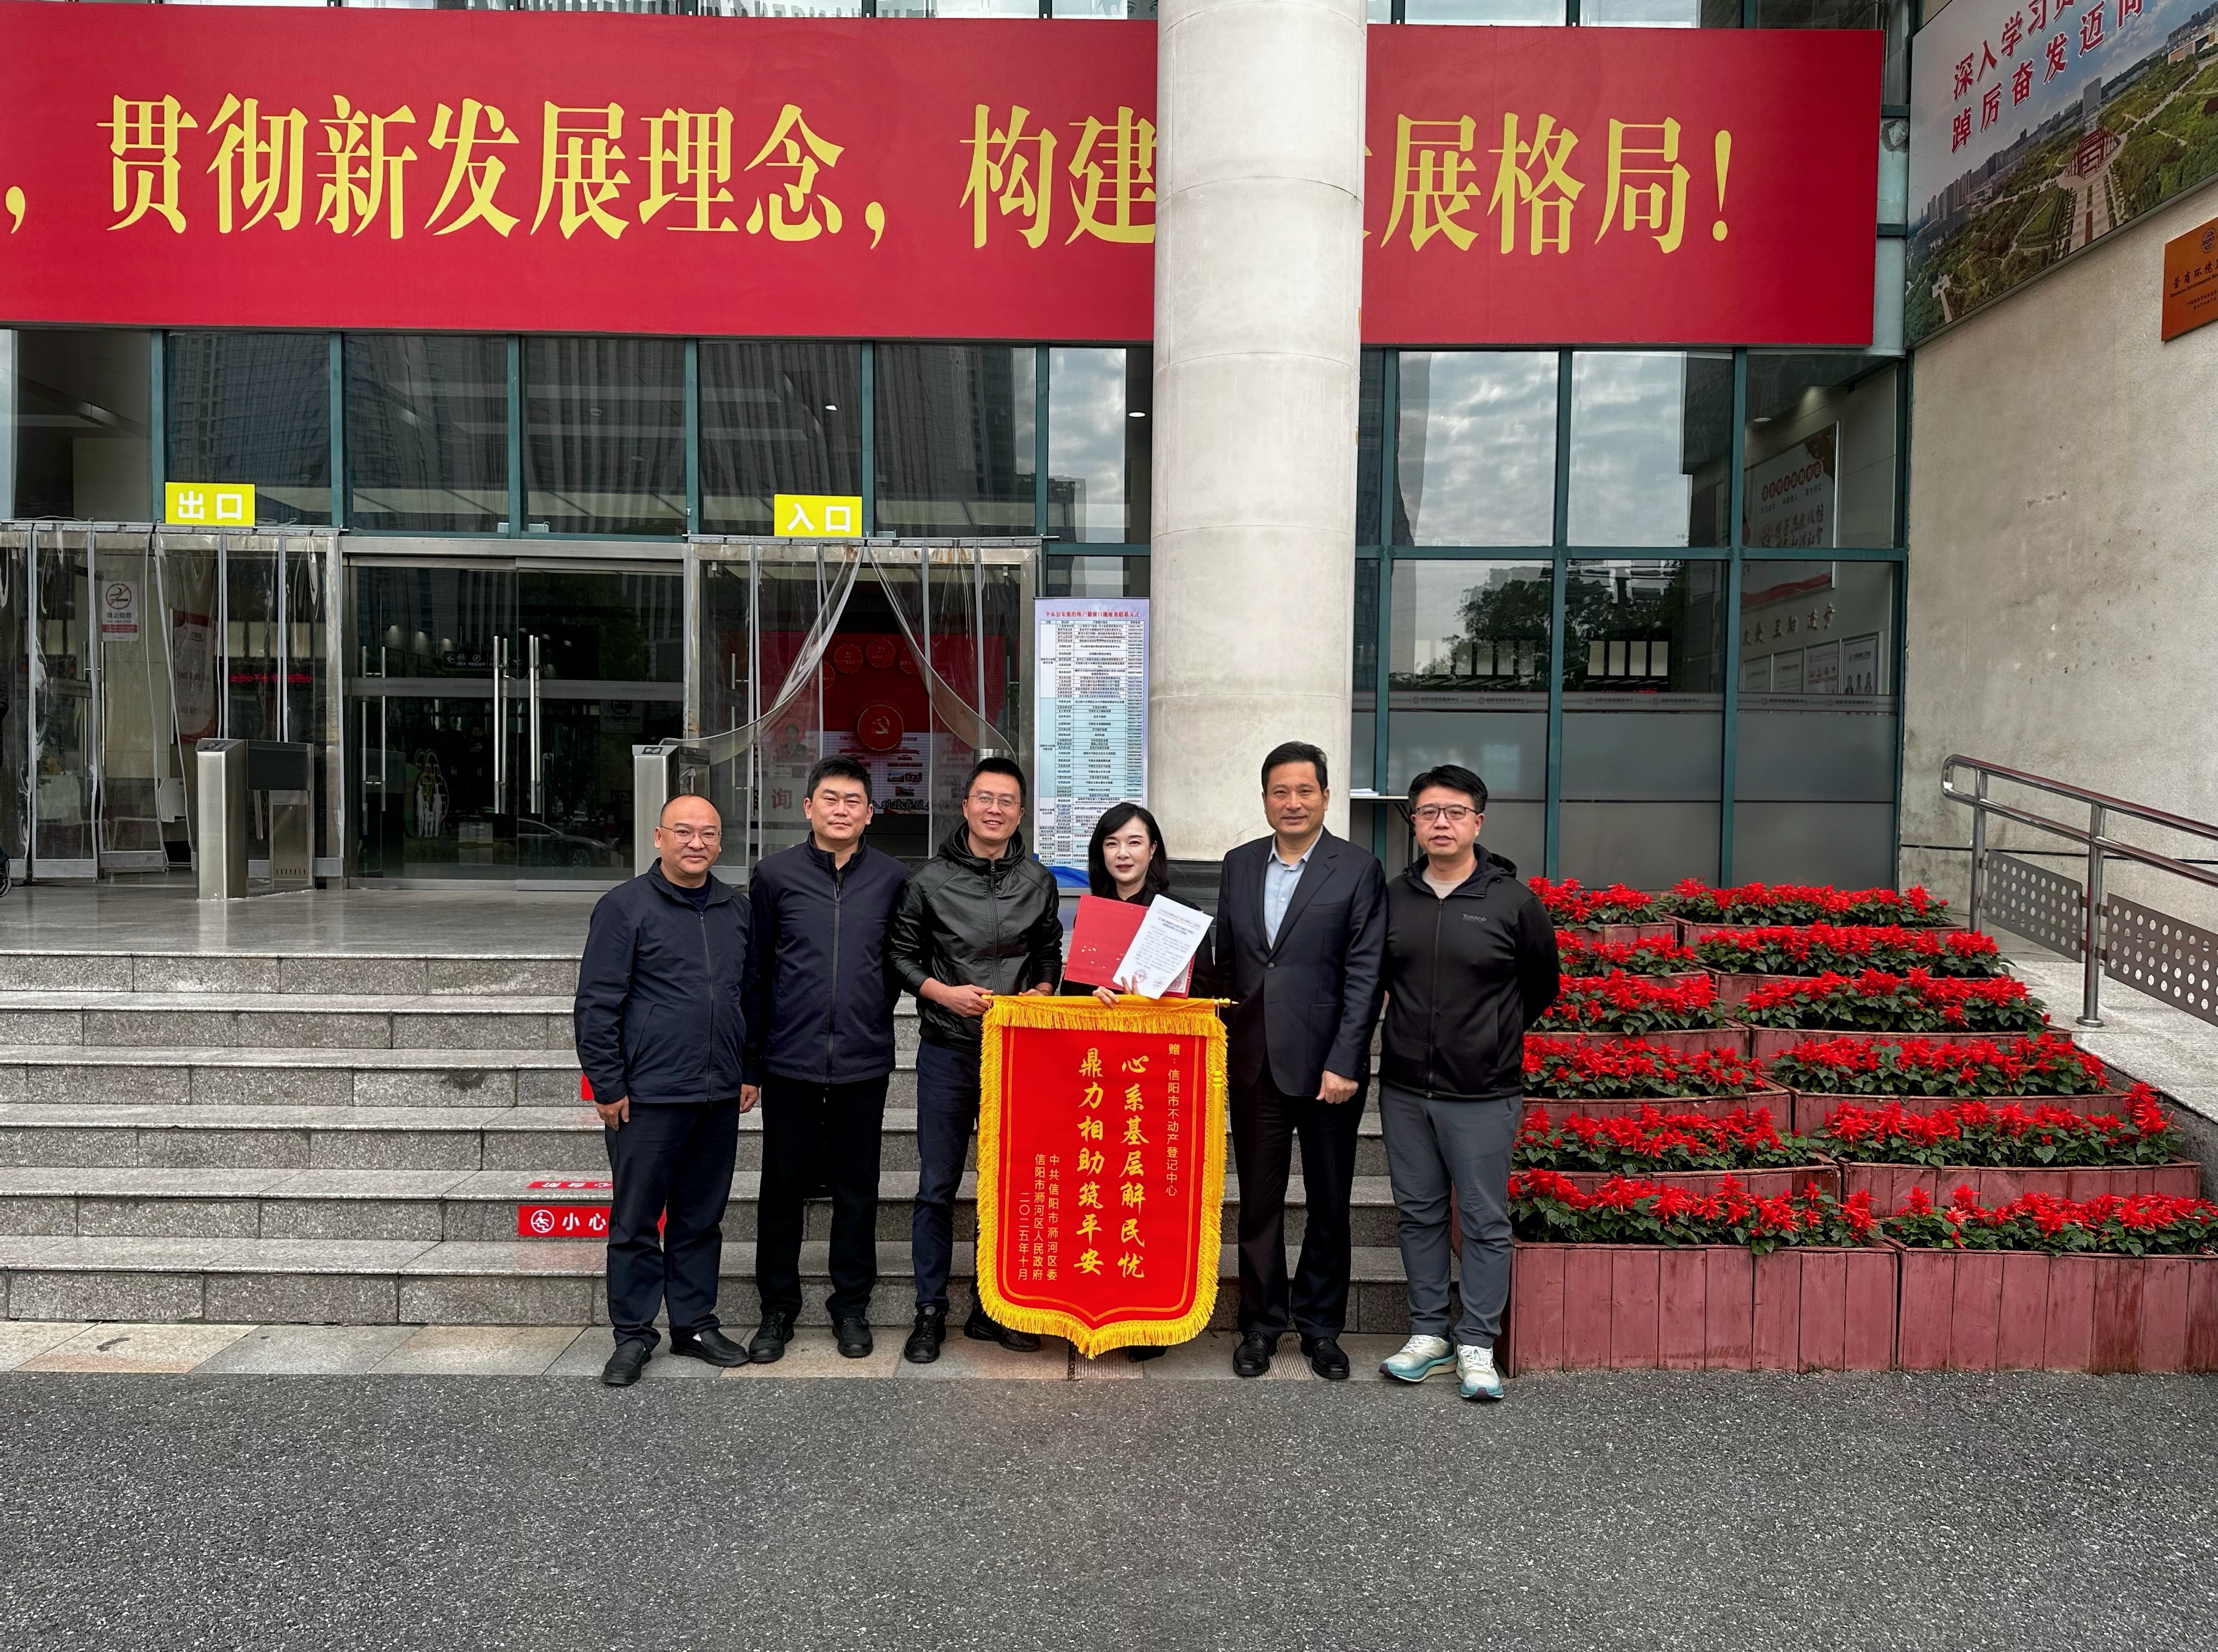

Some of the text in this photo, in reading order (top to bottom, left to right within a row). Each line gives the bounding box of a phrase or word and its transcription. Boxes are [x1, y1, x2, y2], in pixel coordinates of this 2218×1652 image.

[2173, 259, 2218, 289] 营商环境
[178, 490, 243, 520] 出口
[787, 503, 852, 532] 入口
[872, 798, 929, 811] 到政务服
[1165, 1043, 1180, 1196] 赠：信阳市不动产登记中心
[1073, 1048, 1105, 1276] 鼎力相助筑平安
[1117, 1055, 1150, 1279] 心系基层解民忧
[562, 1212, 607, 1230] 小心
[1032, 1153, 1047, 1281] 信阳市浉河区人民政府
[1047, 1153, 1060, 1281] 中共信阳市浉河区委
